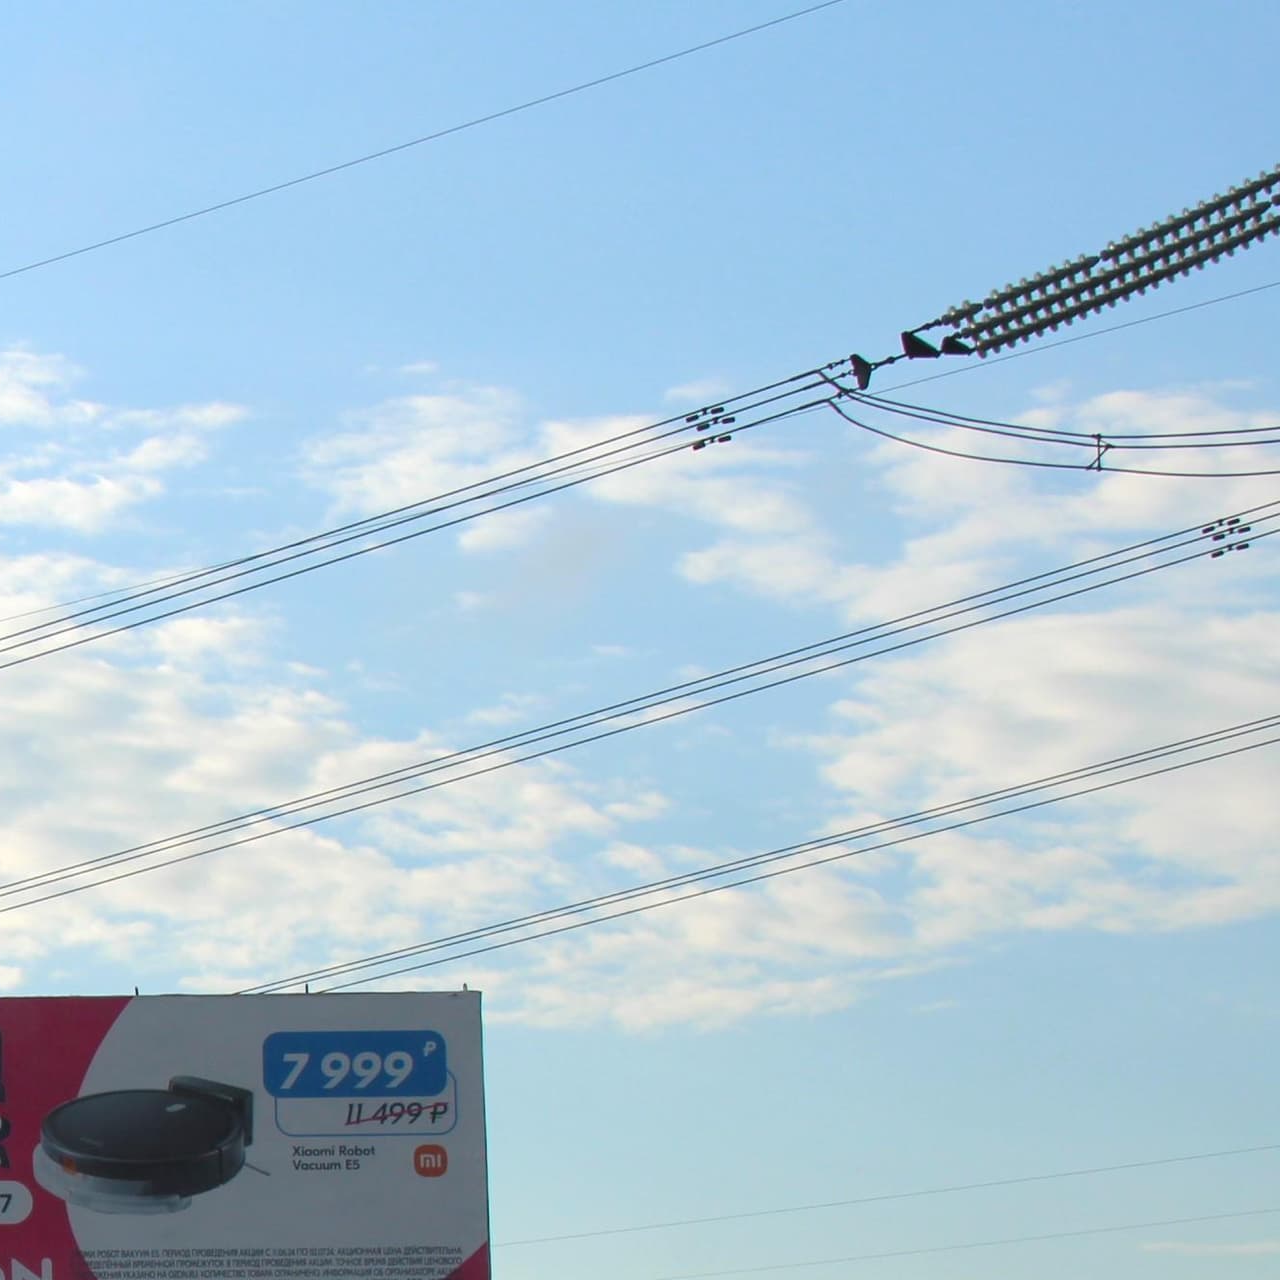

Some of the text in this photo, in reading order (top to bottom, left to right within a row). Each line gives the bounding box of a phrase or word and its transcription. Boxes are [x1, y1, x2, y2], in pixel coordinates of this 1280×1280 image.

[280, 1053, 310, 1090] 7
[320, 1051, 414, 1089] 999
[371, 1102, 423, 1125] 499
[292, 1145, 376, 1157] Xiaomi Robot
[292, 1159, 361, 1171] Vacuum E5
